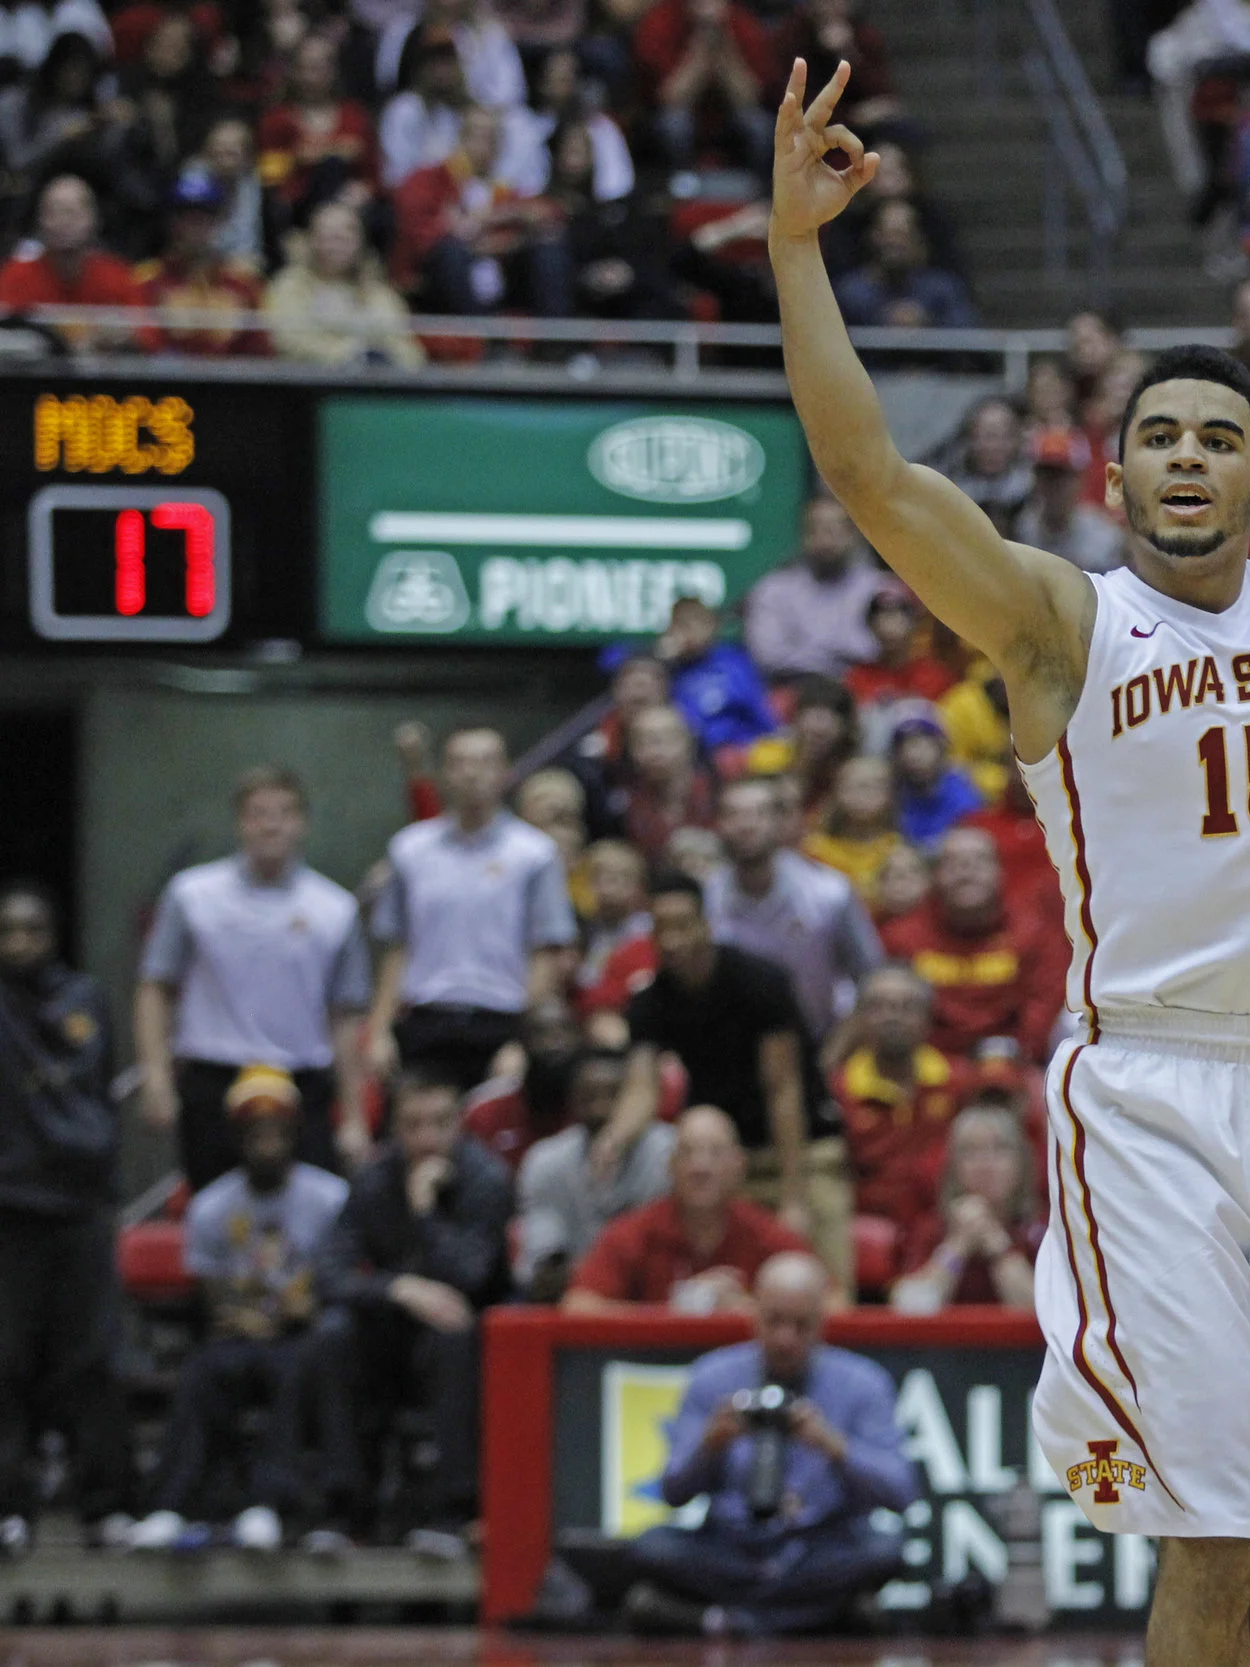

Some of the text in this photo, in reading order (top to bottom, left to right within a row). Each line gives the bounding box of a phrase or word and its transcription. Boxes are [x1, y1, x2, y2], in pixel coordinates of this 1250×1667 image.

[34, 393, 195, 475] MOCS
[115, 502, 216, 617] 17
[1110, 655, 1226, 740] IOWA
[1066, 1459, 1146, 1493] STATE
